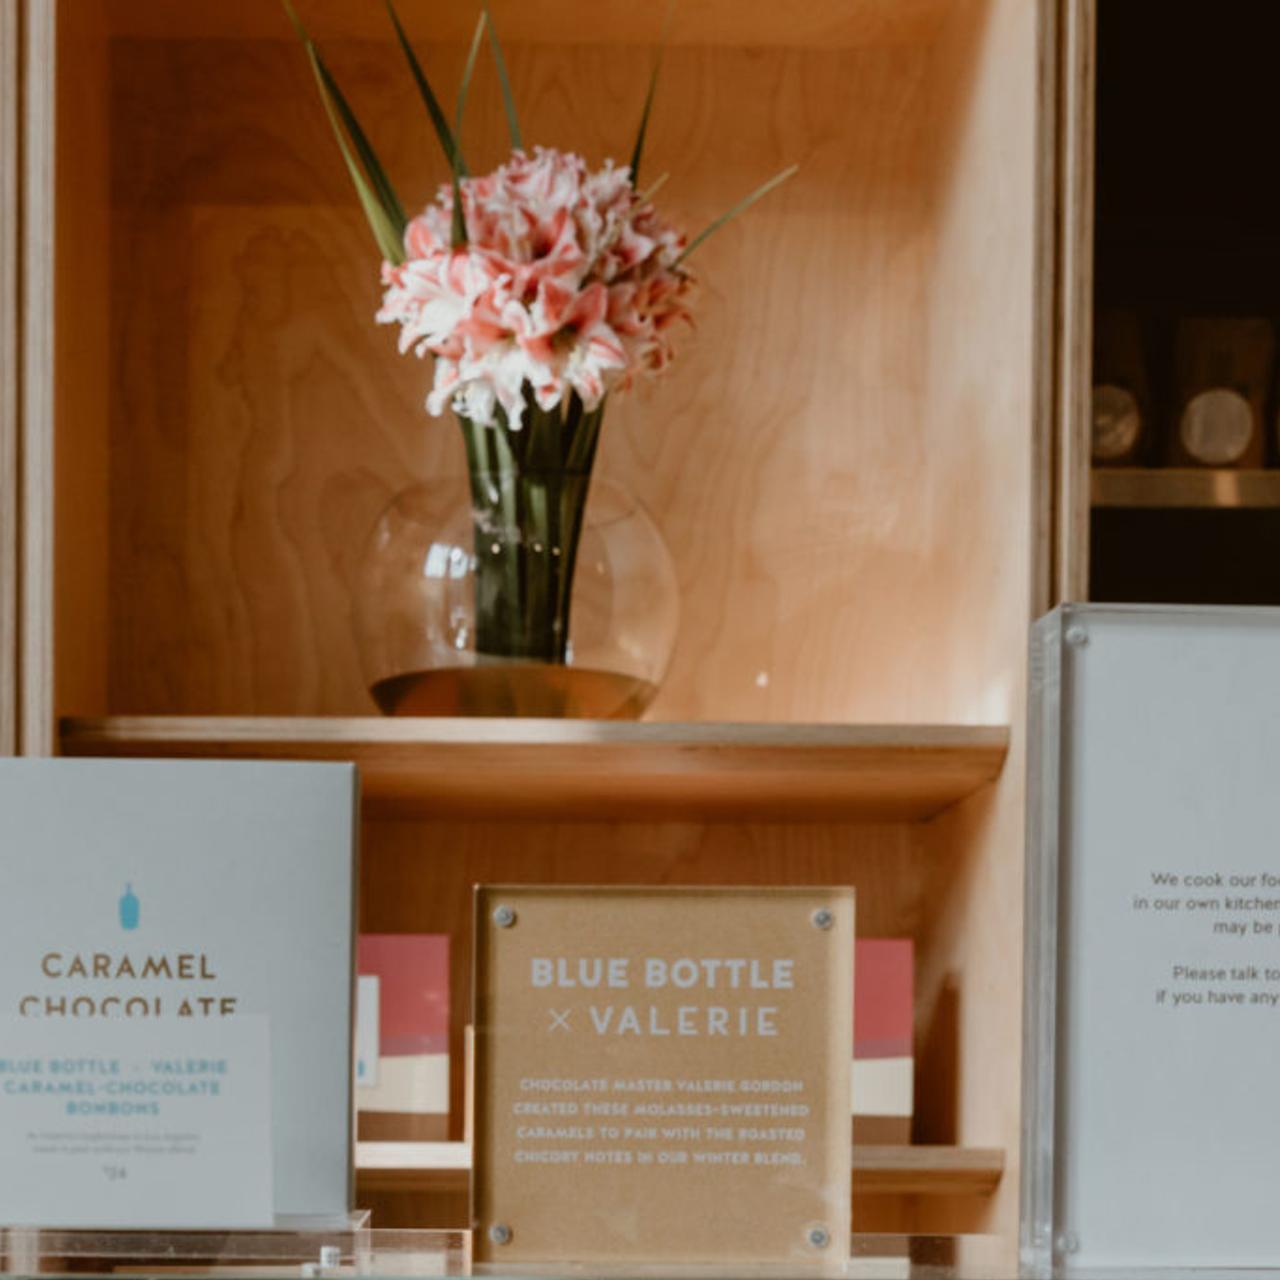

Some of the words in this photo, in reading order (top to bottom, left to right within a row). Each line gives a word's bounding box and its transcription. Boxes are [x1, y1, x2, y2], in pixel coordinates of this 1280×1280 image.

[1151, 872, 1178, 888] We
[1184, 872, 1223, 888] cook
[1230, 872, 1256, 888] our
[1134, 896, 1148, 910] in
[1154, 898, 1180, 910] our
[1186, 898, 1219, 910] own
[1214, 922, 1247, 936] may
[1253, 921, 1273, 933] be
[41, 953, 216, 980] CARAMEL
[531, 958, 628, 988] BLUE
[645, 959, 794, 989] BOTTLE
[1173, 966, 1226, 981] Please
[1231, 966, 1257, 981] talk
[1265, 968, 1280, 981] to
[1156, 991, 1166, 1005] if
[1173, 994, 1202, 1007] you
[1208, 991, 1244, 1005] have
[1250, 993, 1279, 1007] any
[590, 1006, 778, 1036] VALERIE
[50, 1058, 120, 1074] BOTTLE
[152, 1058, 228, 1074] VALERIE
[3, 1080, 220, 1095] CARAMEL-CHOCOLATE
[520, 1078, 608, 1093] CHOCOLATE
[614, 1078, 672, 1093] MASTER
[677, 1078, 734, 1093] VALERIE
[741, 1078, 803, 1093] GORDON
[514, 1102, 577, 1117] CREATED
[584, 1102, 628, 1117] THESE
[634, 1102, 808, 1117] MOLASSES-SWEETENED
[517, 1126, 594, 1141] CARAMELS
[600, 1126, 619, 1141] TO
[625, 1126, 657, 1141] PAIR
[663, 1126, 699, 1141] WITH
[706, 1126, 732, 1141] THE
[739, 1126, 805, 1141] ROASTED
[514, 1150, 578, 1165] CHICORY
[585, 1151, 632, 1165] NOTES
[638, 1151, 652, 1165] IN
[658, 1152, 688, 1165] OUR
[694, 1152, 749, 1165] WINTER
[754, 1152, 805, 1167] BLEND.
